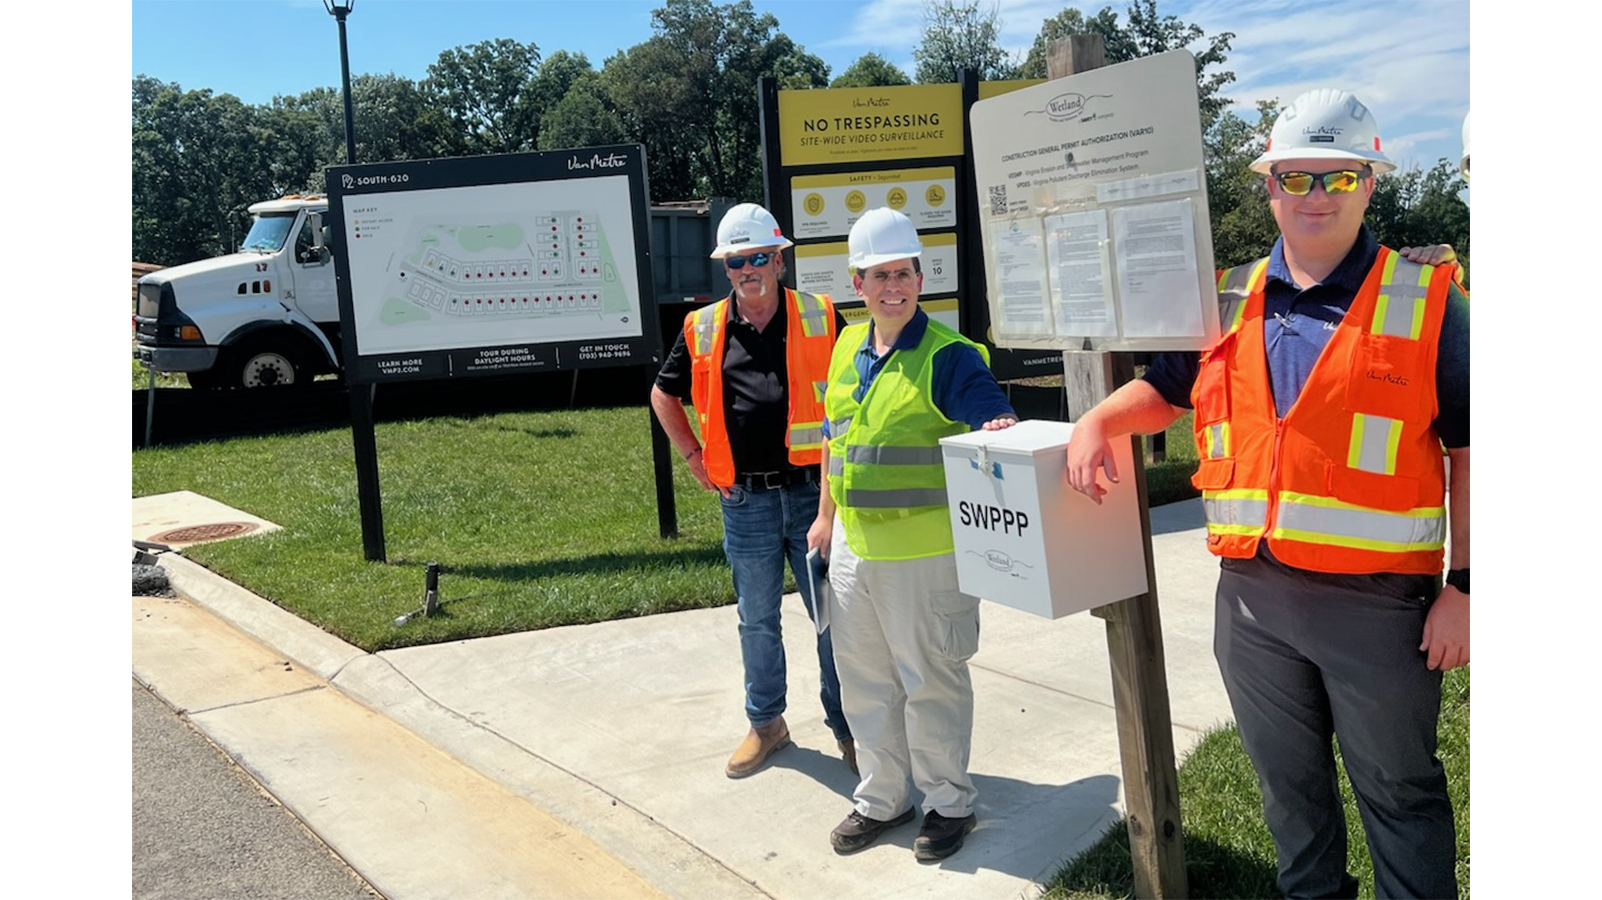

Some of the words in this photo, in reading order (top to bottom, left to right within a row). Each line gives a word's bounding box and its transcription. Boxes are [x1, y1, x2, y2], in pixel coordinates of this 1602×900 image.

[1050, 96, 1081, 113] Wetland
[804, 118, 828, 132] NO
[834, 113, 940, 130] TRESPASSING
[800, 135, 846, 146] SITE-WIDE
[848, 133, 877, 144] VIDEO
[879, 130, 944, 142] SURVEILLANCE
[1002, 150, 1037, 162] CONSTRUCTION
[1038, 145, 1060, 155] GENERAL
[1060, 140, 1080, 150] PERMIT
[1081, 132, 1128, 146] AUTHORIZATION
[1130, 126, 1154, 138] (VAR10)
[568, 155, 589, 170] Van
[590, 153, 628, 170] Metre
[1025, 168, 1040, 176] Virginia
[1092, 153, 1124, 164] Management
[1125, 150, 1149, 158] Program
[1049, 175, 1067, 183] Pollutant
[1068, 172, 1090, 180] Discharge
[1091, 167, 1118, 177] Elimination
[1119, 164, 1139, 173] System
[933, 266, 942, 275] 10
[844, 310, 870, 318] ERGENC
[474, 356, 509, 364] DAYLIGHT
[510, 354, 536, 362] HOURS
[480, 350, 499, 358] TOUR
[500, 348, 529, 356] DURING
[579, 352, 598, 360] (703)
[378, 360, 401, 368] LEARN
[382, 366, 420, 374] VMP2.COM
[1366, 370, 1382, 382] Van
[1382, 372, 1410, 386] Metre
[959, 500, 1029, 537] SWPPP
